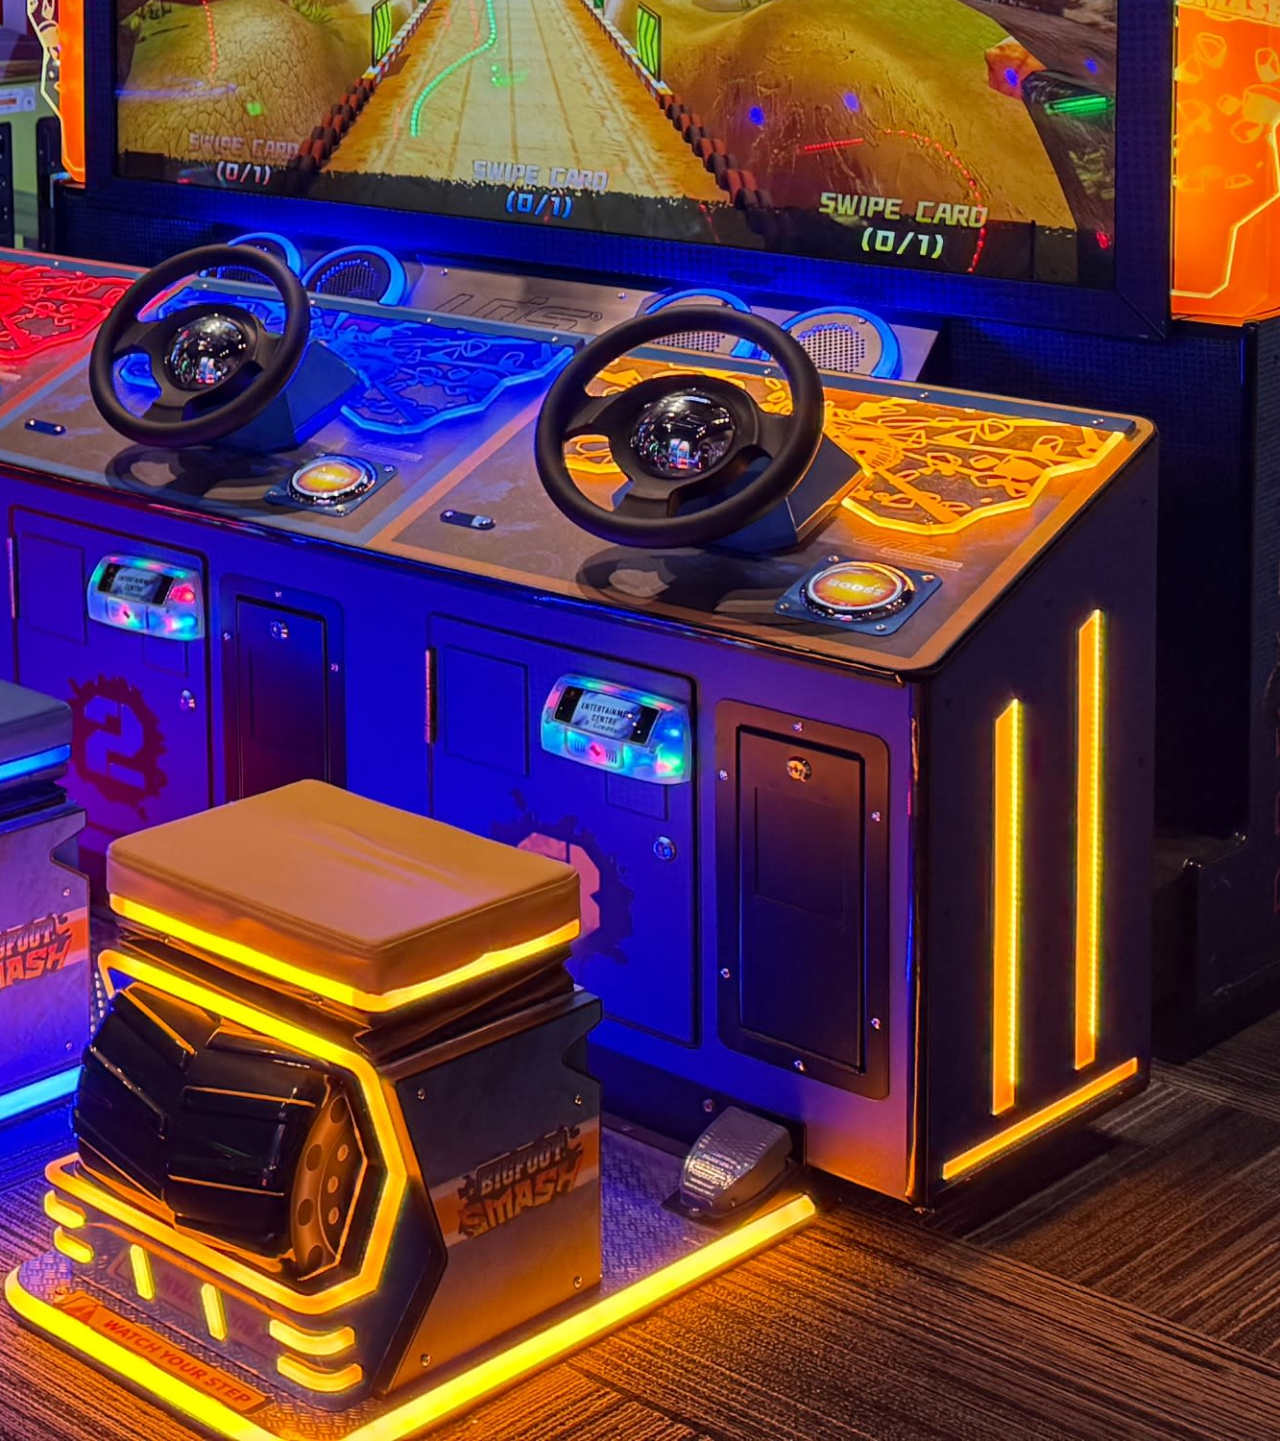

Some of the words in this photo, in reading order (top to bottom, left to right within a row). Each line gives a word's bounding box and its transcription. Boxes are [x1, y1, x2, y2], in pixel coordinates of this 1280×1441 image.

[189, 133, 244, 152] SWIPE
[252, 138, 300, 159] CARD
[216, 161, 272, 185] (0/1)
[473, 160, 539, 186] SWIPE
[550, 167, 608, 191] CARD
[506, 190, 573, 219] (0/1)
[818, 192, 903, 220] SWIPE
[916, 200, 988, 228] CARD
[861, 227, 944, 259] (0/1)
[460, 1158, 581, 1239] SMASH
[104, 1320, 159, 1354] WATCH
[161, 1350, 208, 1380] YOUR
[205, 1378, 251, 1404] STEP
